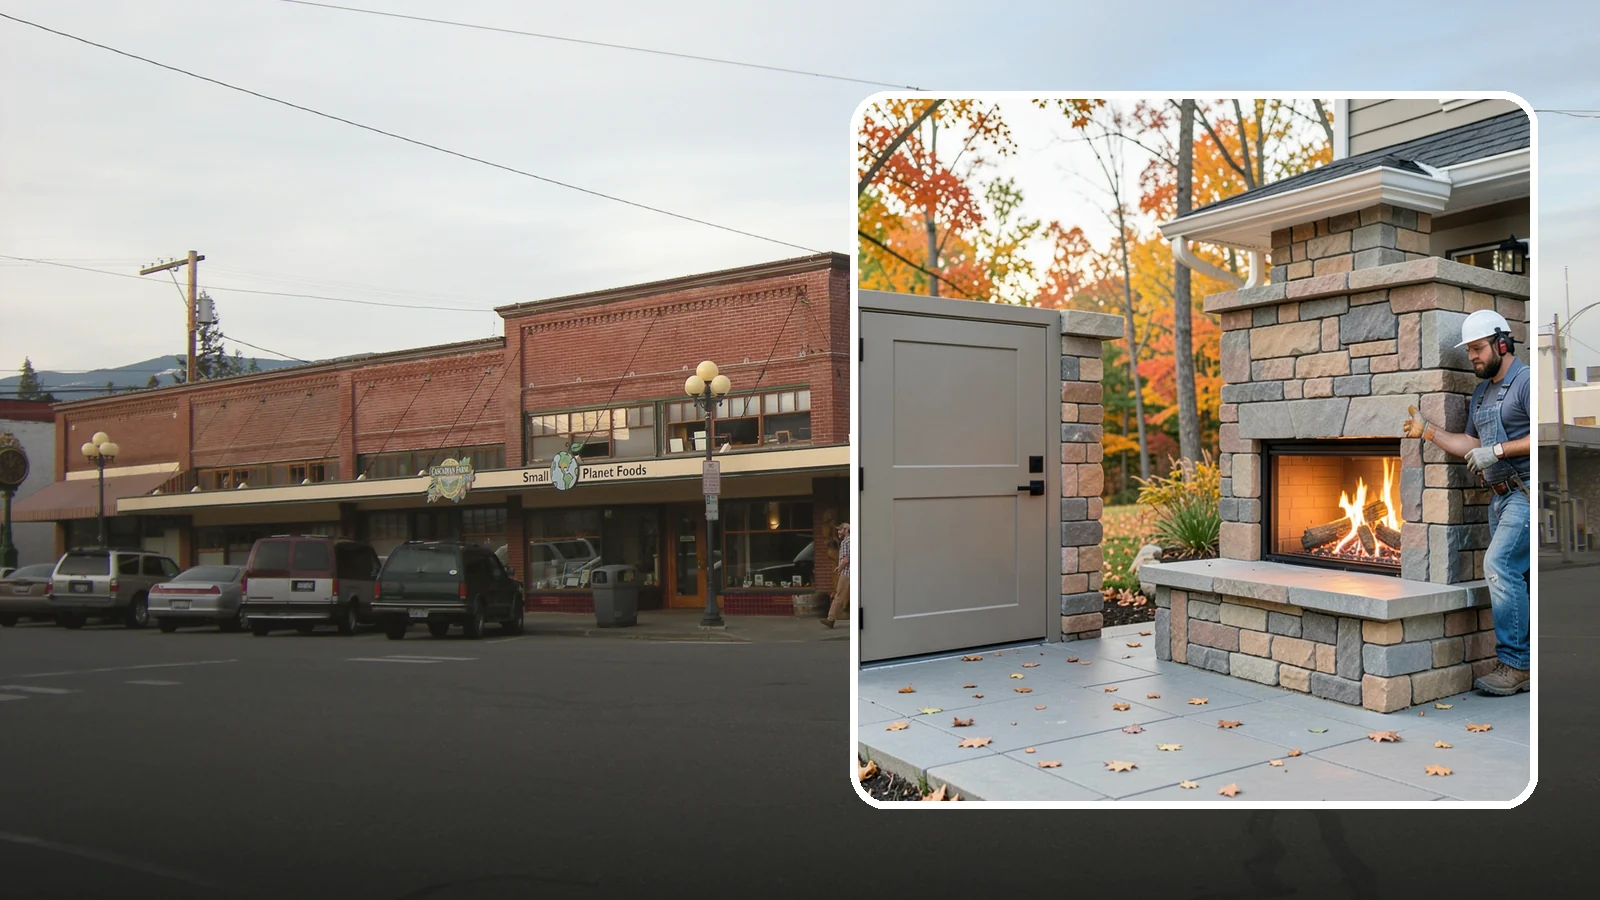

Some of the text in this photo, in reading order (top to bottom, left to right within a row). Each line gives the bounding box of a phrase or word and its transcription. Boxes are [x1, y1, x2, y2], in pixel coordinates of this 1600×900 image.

[523, 464, 647, 483] Small Planet Foods
